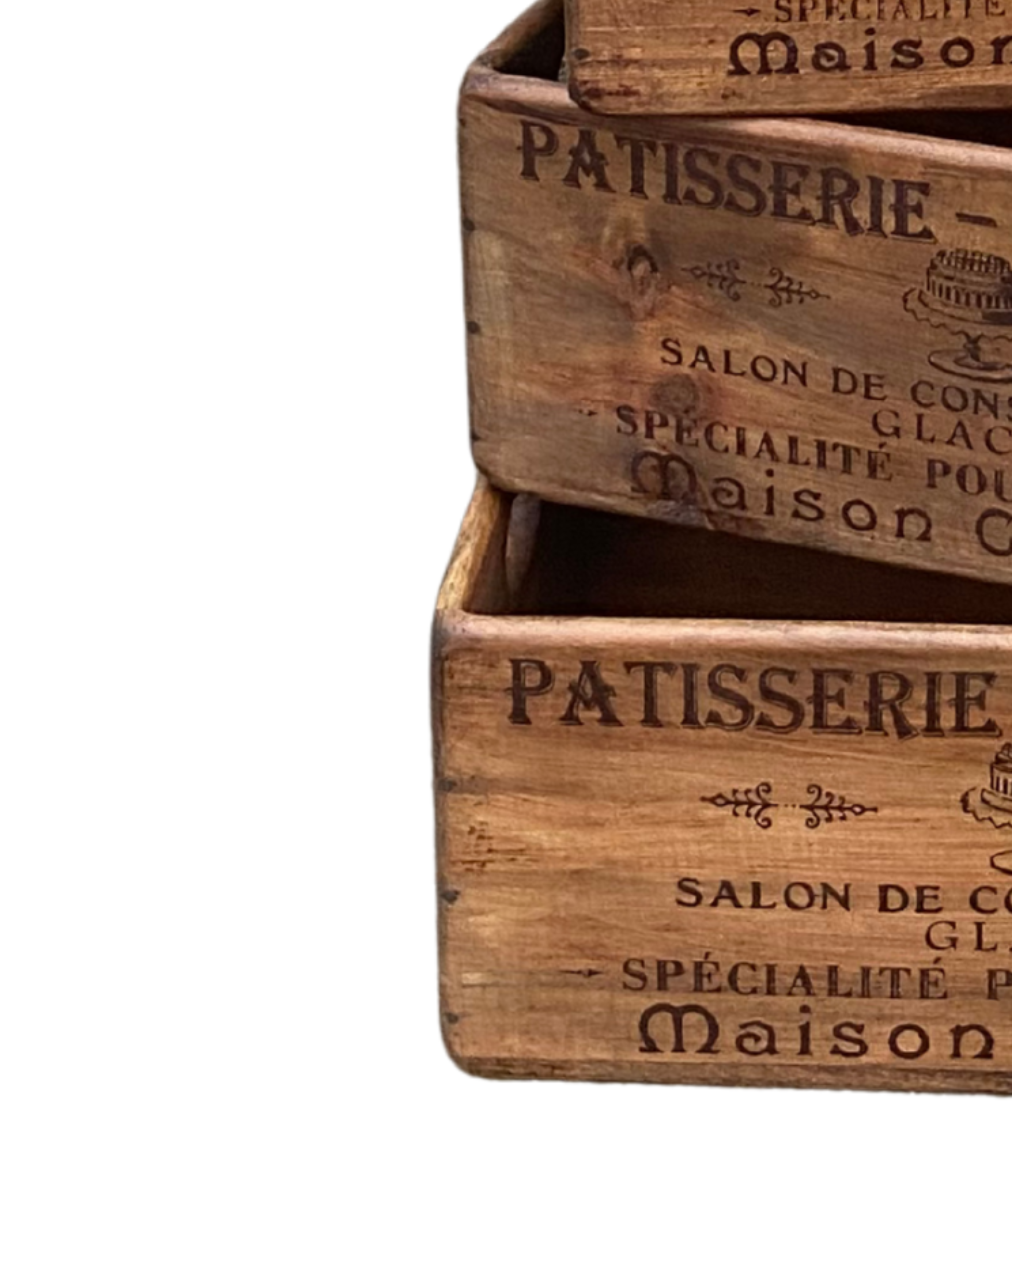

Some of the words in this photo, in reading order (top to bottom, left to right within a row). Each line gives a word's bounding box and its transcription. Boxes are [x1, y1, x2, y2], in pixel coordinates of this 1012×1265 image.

[517, 118, 936, 241] PATISSERIE
[660, 337, 809, 389] SALON
[832, 365, 887, 403] DE
[615, 404, 893, 484] SPÉCIALITÉ
[629, 447, 933, 542] Maison
[504, 658, 1002, 739] PATISSERIE
[676, 878, 851, 915] SALON
[878, 883, 943, 915] DE
[622, 953, 948, 1002] SPÉCIALITÉ
[638, 1002, 995, 1063] Maison
